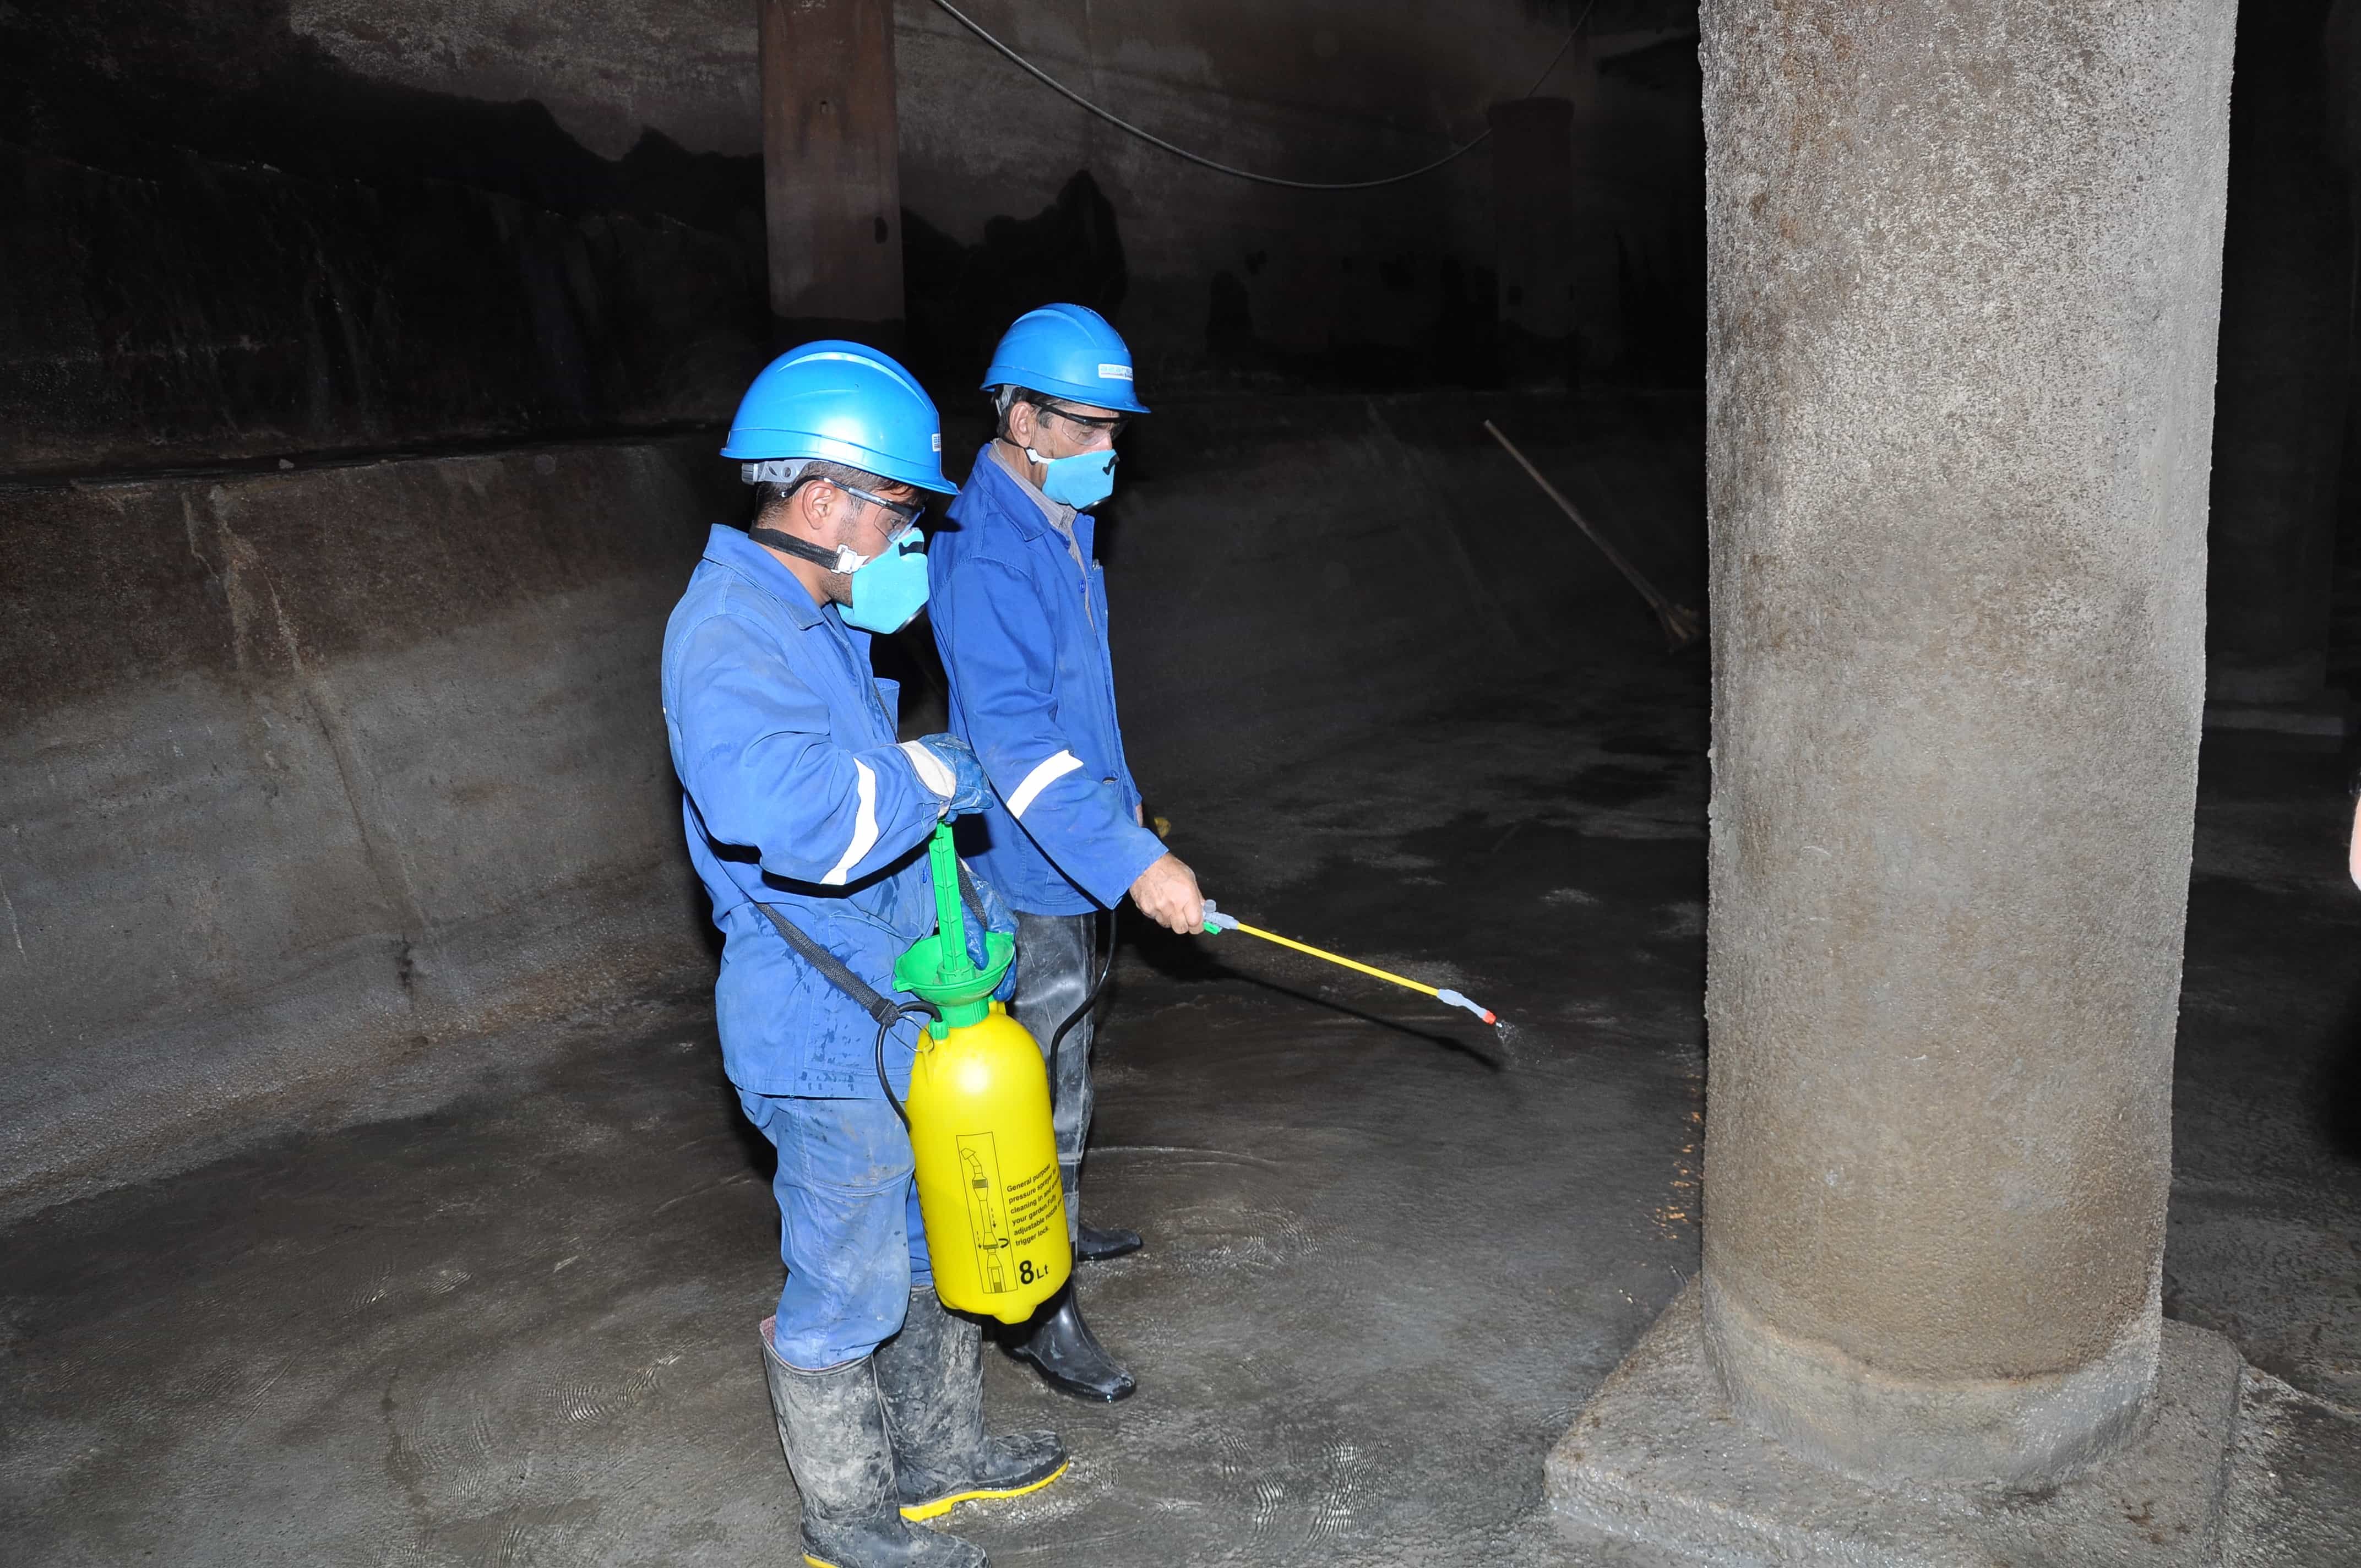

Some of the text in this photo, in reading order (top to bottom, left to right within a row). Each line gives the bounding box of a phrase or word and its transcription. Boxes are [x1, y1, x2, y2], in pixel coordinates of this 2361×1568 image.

[1007, 1163, 1051, 1192] General purpose
[1009, 1188, 1036, 1205] pressure
[1010, 1200, 1037, 1214] cleaning
[1012, 1215, 1027, 1227] your
[1014, 1217, 1045, 1235] adjustable
[1015, 1234, 1036, 1246] trigger
